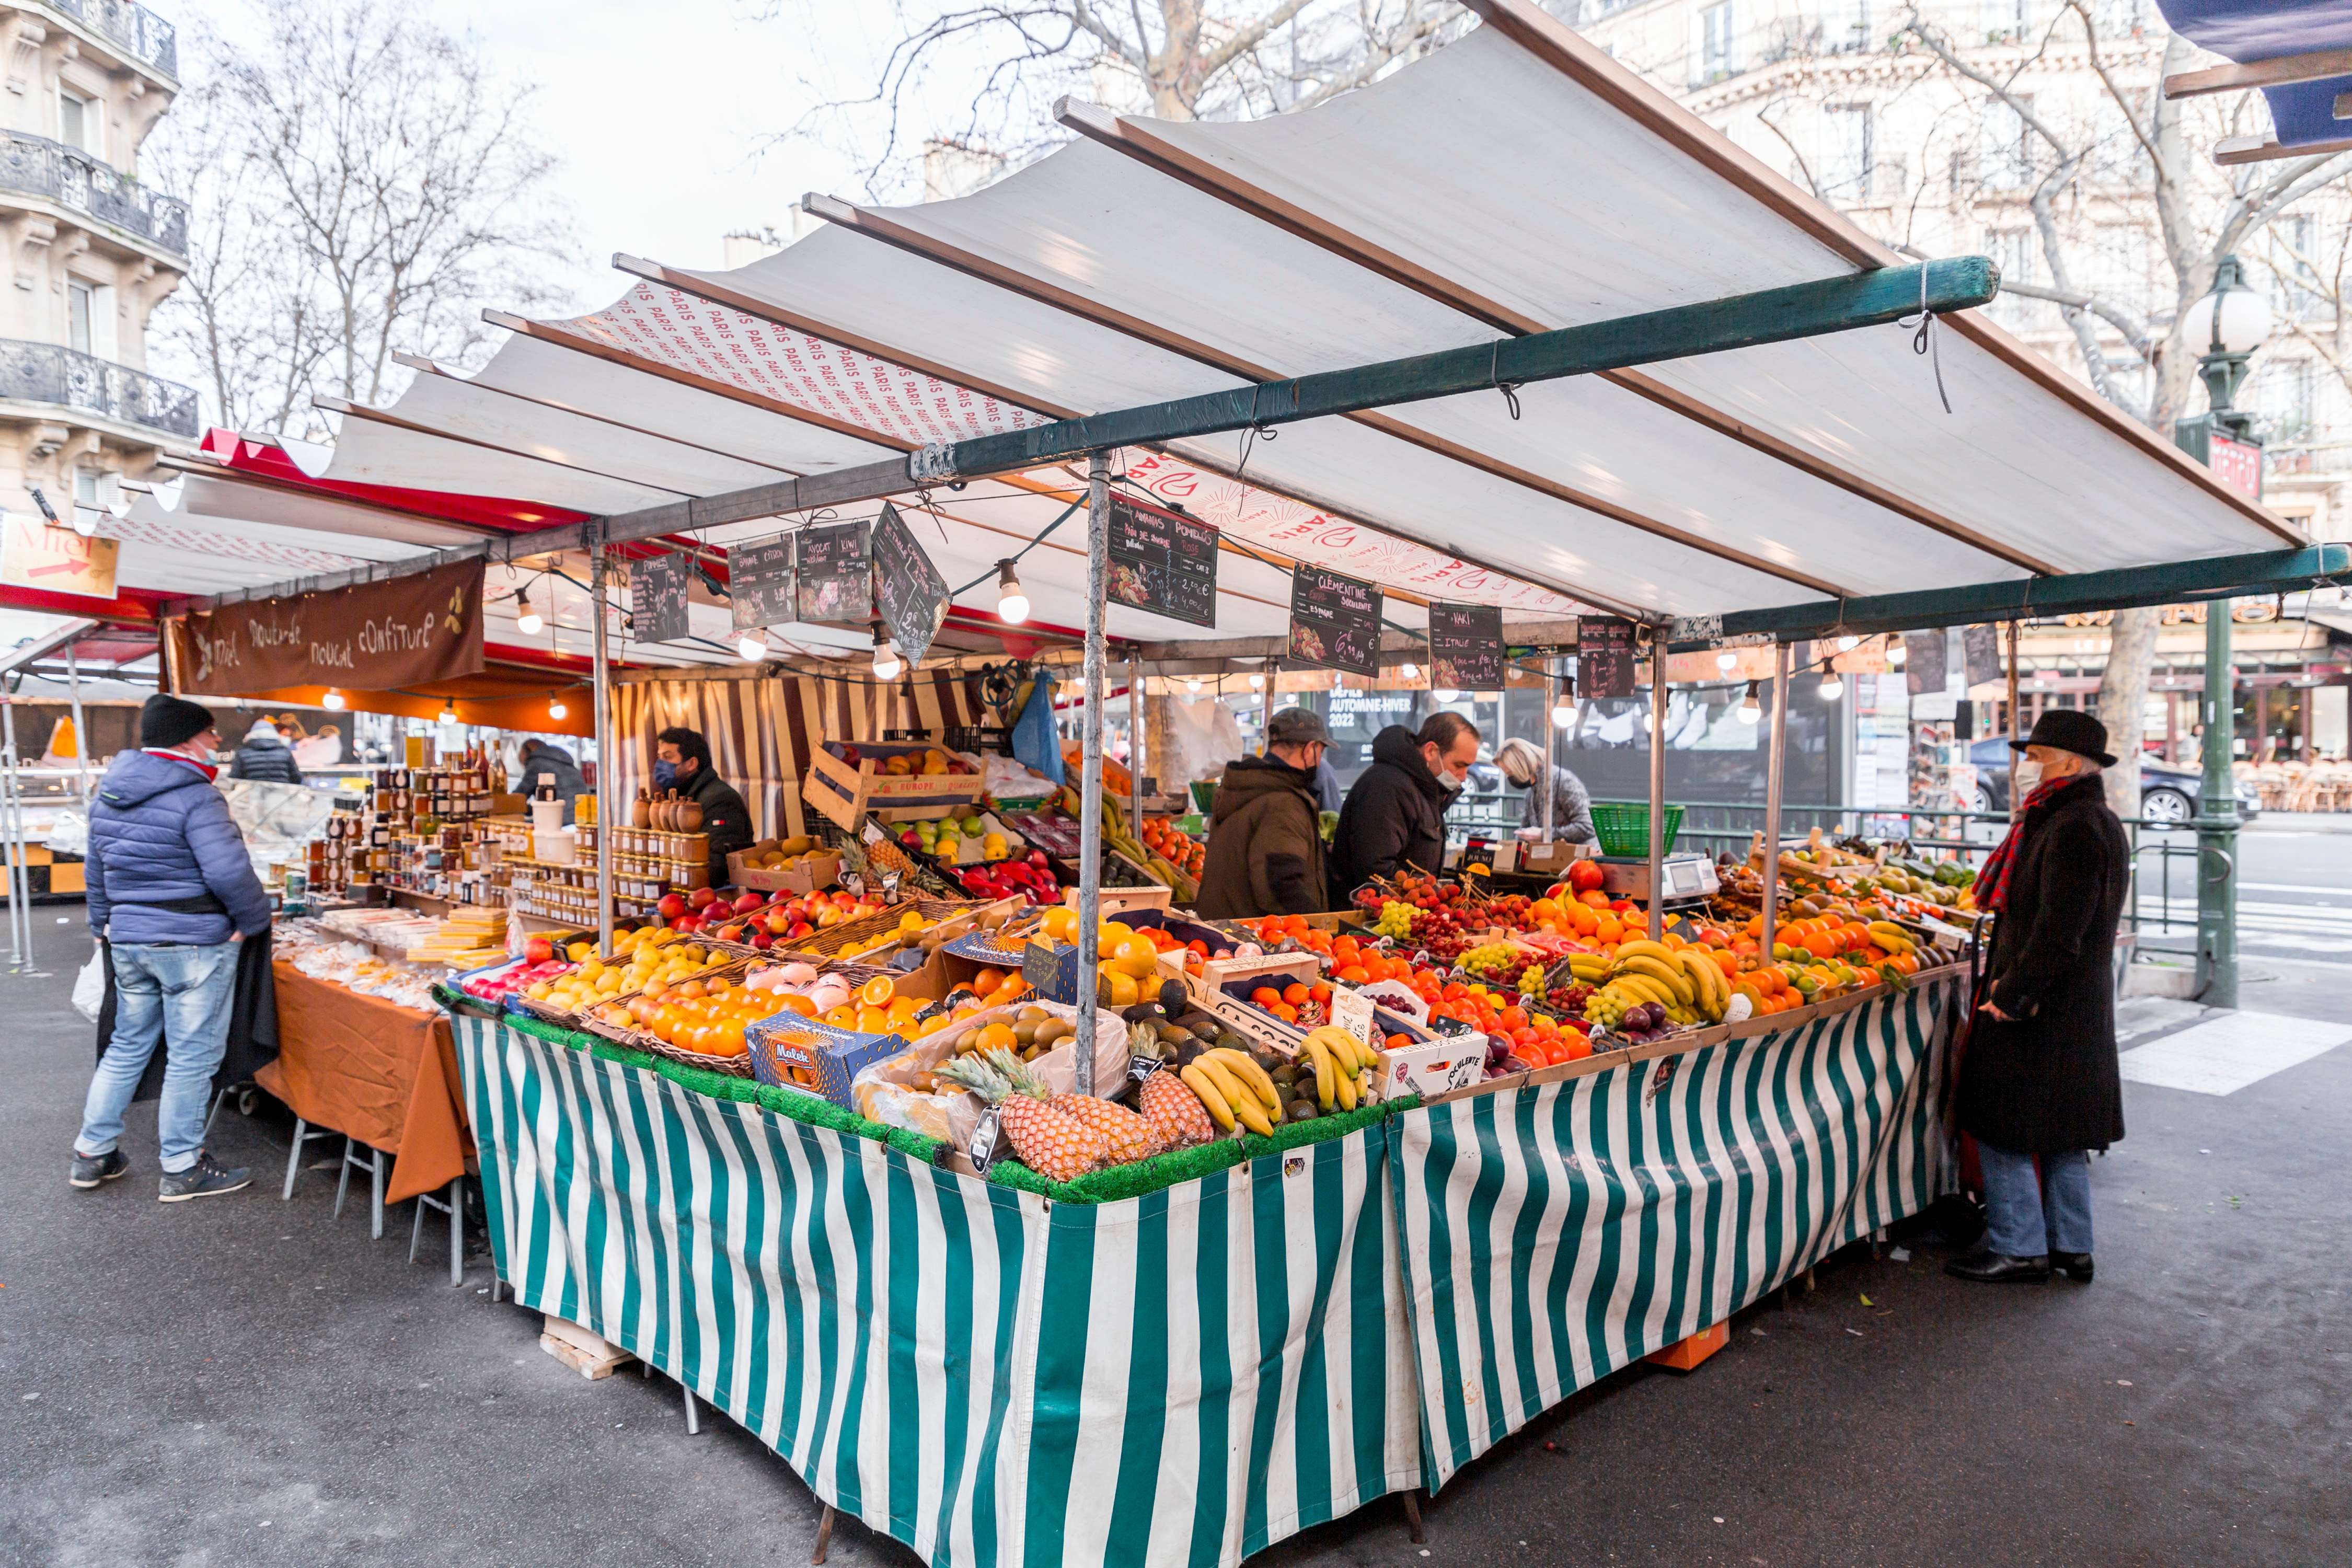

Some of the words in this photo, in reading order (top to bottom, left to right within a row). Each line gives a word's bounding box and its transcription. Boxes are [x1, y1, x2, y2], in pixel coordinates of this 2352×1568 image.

[665, 290, 696, 321] PARIS
[629, 318, 660, 339] PARIS
[647, 307, 677, 332] PARIS
[706, 310, 734, 339] PARIS
[670, 335, 698, 355] PARIS
[687, 326, 716, 349] PARIS
[745, 330, 771, 356] PARIS
[709, 351, 735, 370] PARIS
[726, 343, 753, 365] PARIS
[781, 348, 807, 373] PARIS
[837, 349, 860, 377] PARIS
[763, 360, 788, 379] PARIS
[817, 365, 840, 387] PARIS
[871, 366, 892, 393] PARIS
[798, 375, 822, 394] PARIS
[851, 381, 872, 400] PARIS
[902, 382, 923, 407] PARIS
[883, 396, 904, 412] PARIS
[933, 397, 952, 419] PARIS
[983, 396, 1001, 422] PARIS
[963, 412, 981, 429] PARIS
[1237, 510, 1267, 523] PARIS
[1135, 510, 1165, 530] ANANAS
[1175, 522, 1213, 546] POMELOS
[17, 522, 92, 558] Miel
[808, 541, 832, 554] AVOCAT
[1181, 540, 1200, 554] ROSE
[764, 549, 783, 562] CITRON
[1203, 583, 1209, 596] €
[1318, 575, 1368, 601] CLÉMENTINE
[1453, 611, 1470, 626] KAKI
[1368, 638, 1375, 649] €
[1329, 698, 1411, 712] AUTOMNE-HIVER
[1329, 712, 1354, 727] 2022
[777, 1044, 810, 1063] Malek
[1397, 1039, 1457, 1053] SOCULENTE
[1447, 1056, 1481, 1086] SOCULENTE
